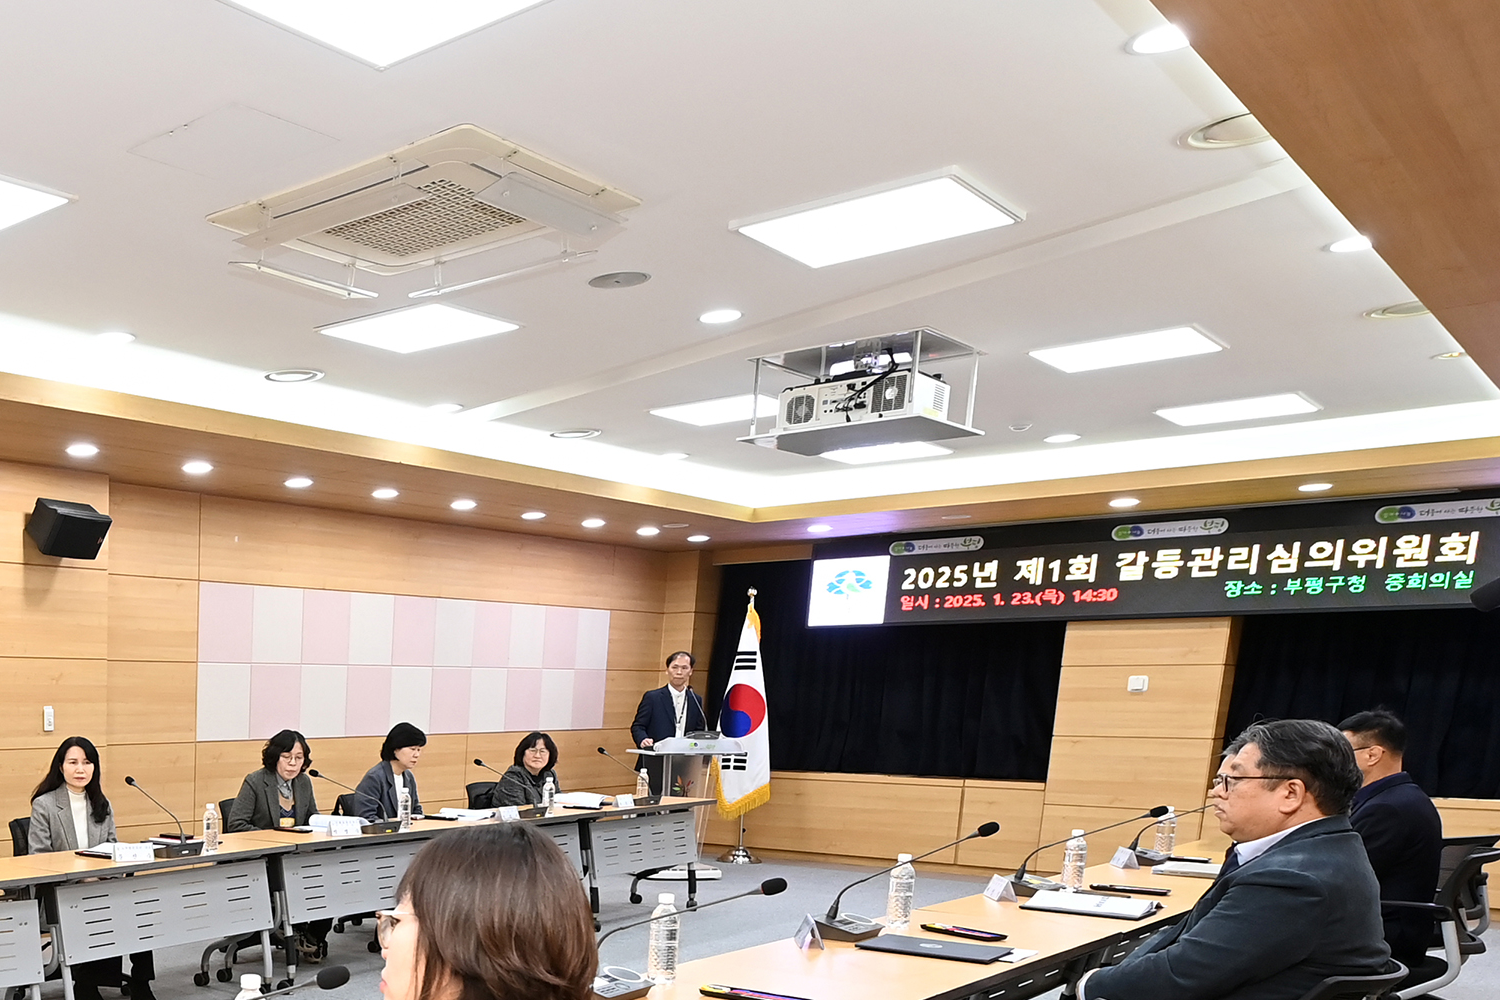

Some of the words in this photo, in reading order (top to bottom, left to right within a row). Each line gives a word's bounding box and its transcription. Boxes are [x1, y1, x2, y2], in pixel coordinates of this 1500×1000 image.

[901, 560, 998, 590] 2025년
[1013, 553, 1099, 586] 제1회
[1115, 531, 1480, 582] 갈등관리심의위원회
[1224, 580, 1263, 598] 장소
[1283, 574, 1367, 596] 부평구청
[900, 595, 929, 611] 일시
[943, 594, 986, 608] 2025.
[993, 593, 1005, 606] 1.
[1010, 588, 1066, 606] 23.(목)
[1072, 588, 1119, 603] 14:30
